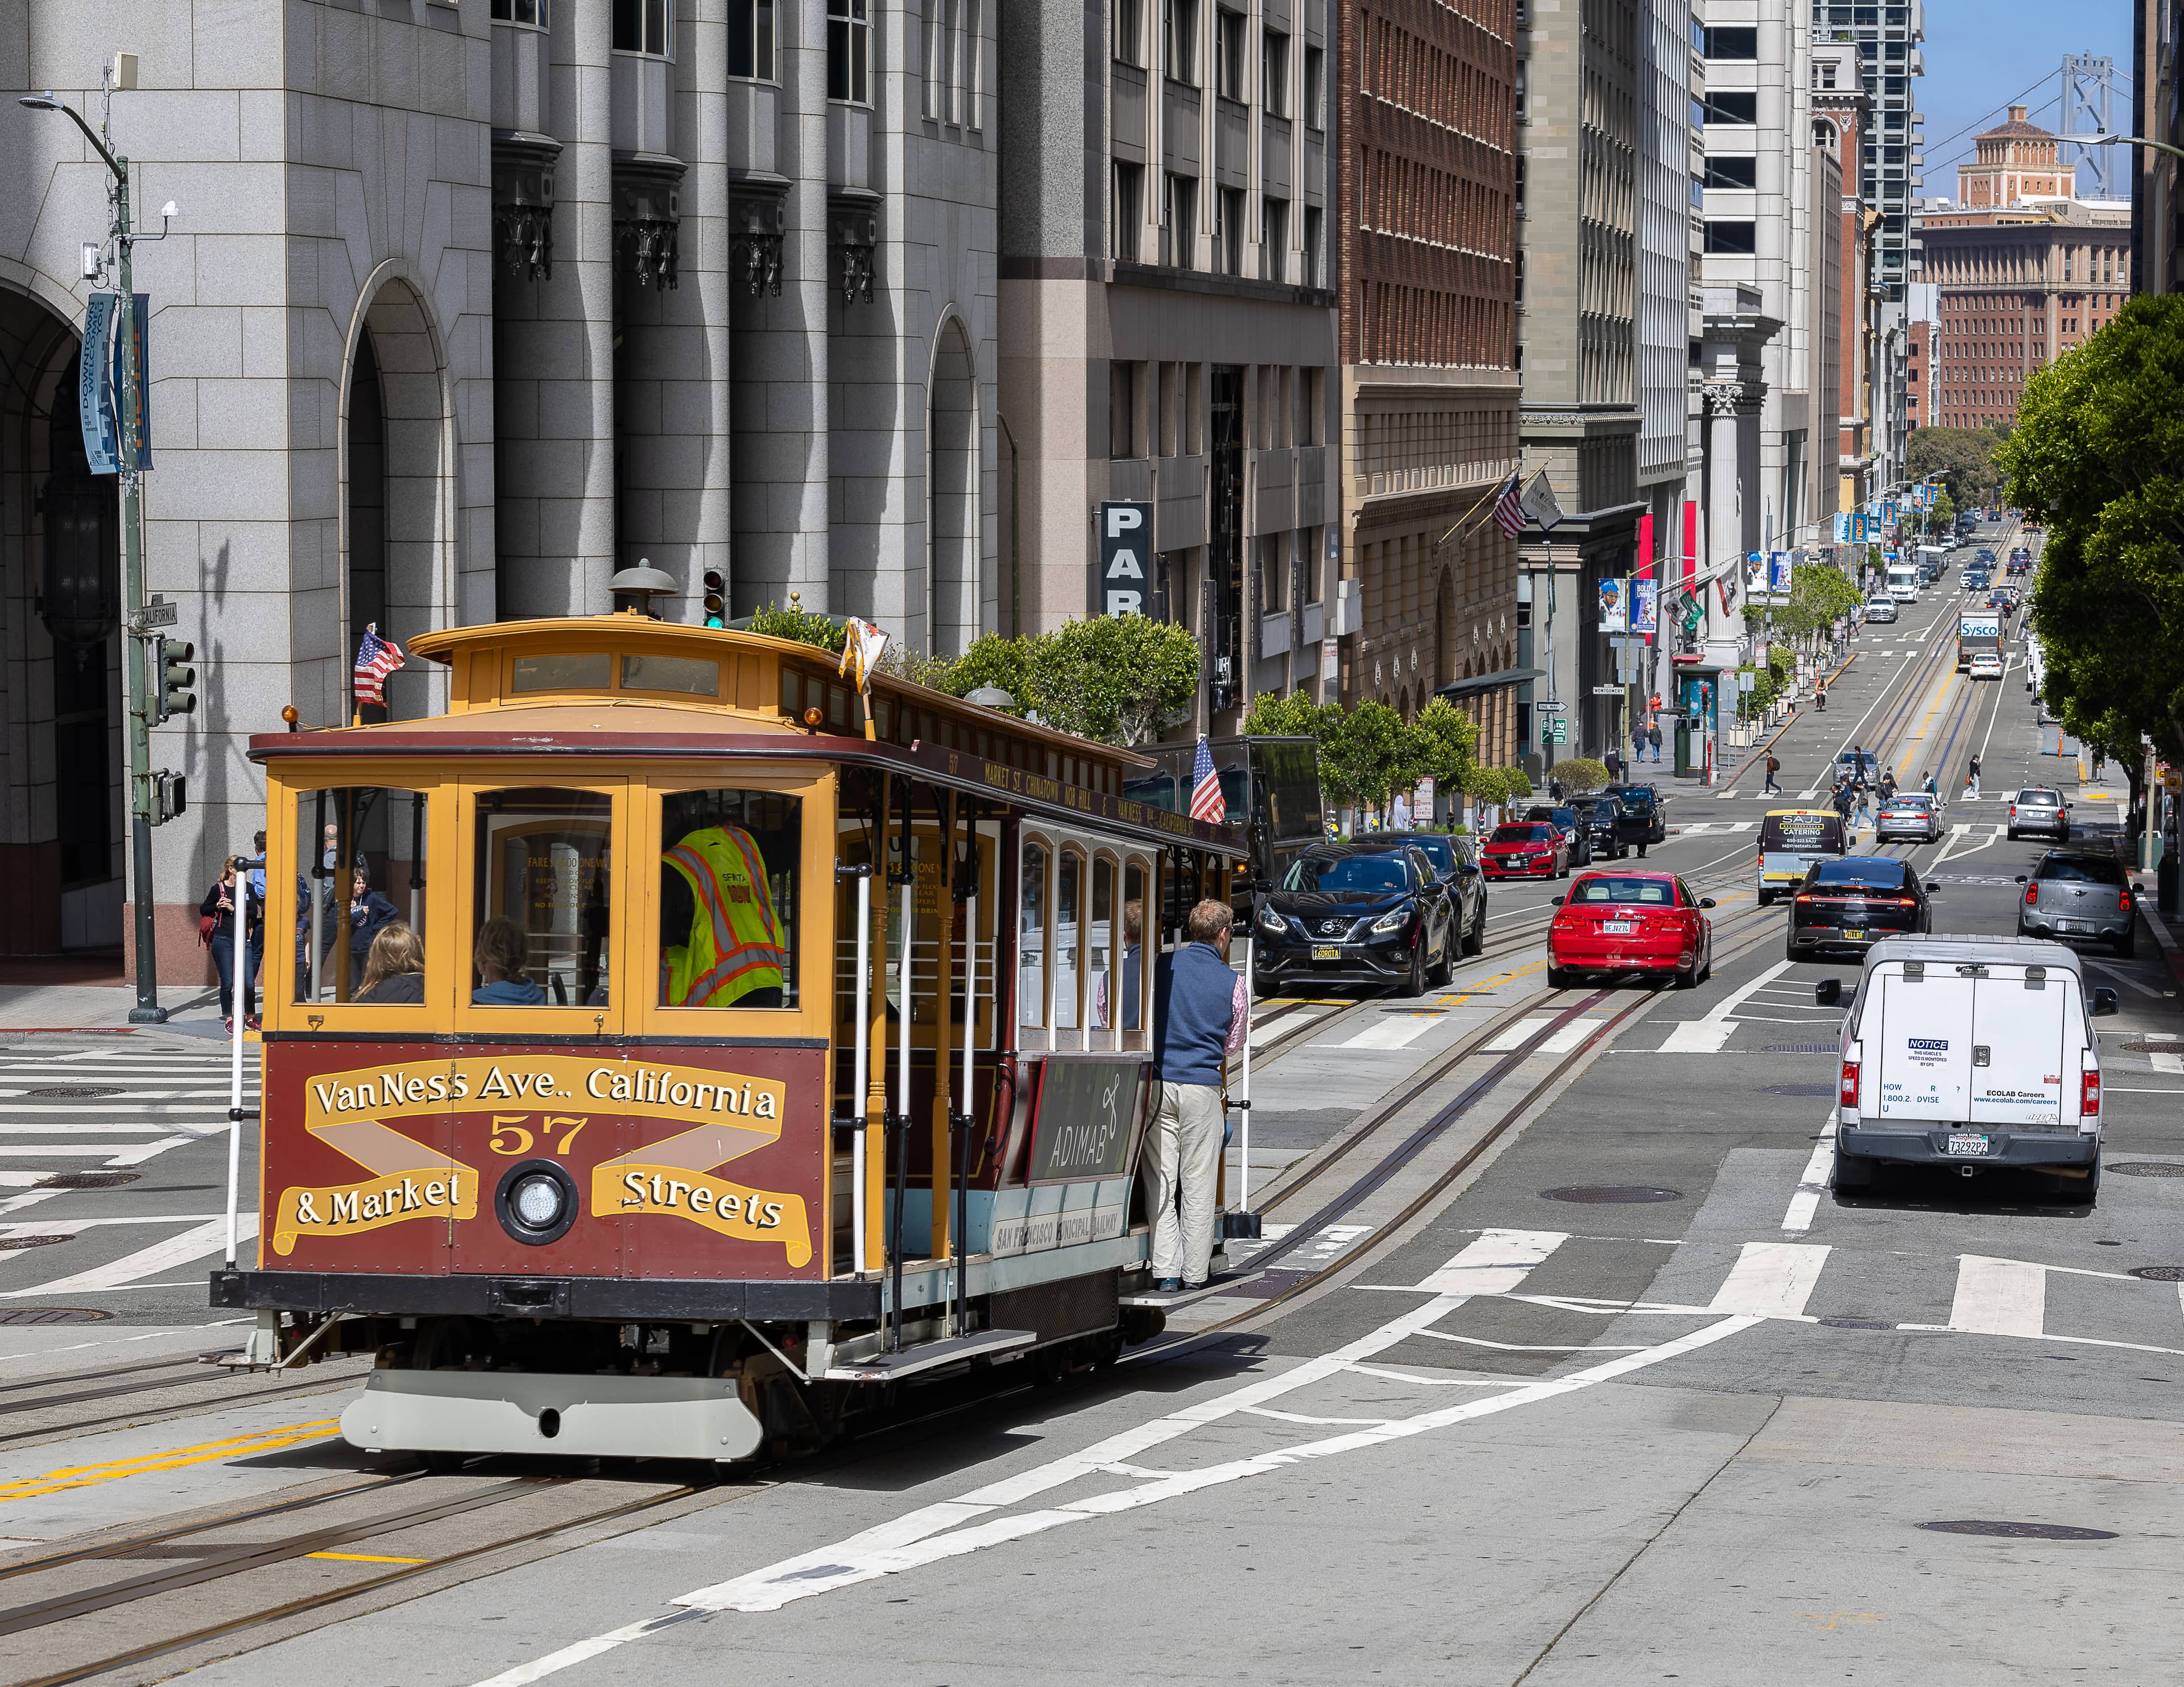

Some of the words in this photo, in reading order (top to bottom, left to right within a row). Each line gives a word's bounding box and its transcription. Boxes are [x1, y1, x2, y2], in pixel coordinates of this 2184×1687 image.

[83, 302, 96, 408] DOWNTOWN
[88, 301, 100, 393] WELCOMES
[1962, 623, 1997, 637] Sysco
[949, 754, 959, 774] 57
[985, 762, 1010, 789] MARKET
[1026, 775, 1059, 802] CHINATOWN
[1064, 786, 1076, 807] NOB
[1078, 790, 1091, 811] HILL
[1118, 801, 1129, 820] VAN
[1129, 803, 1143, 823] NESS
[1160, 811, 1187, 835] CALIFORNIA
[528, 857, 549, 867] FARE
[919, 863, 936, 873] ONE
[1910, 1040, 1947, 1049] NOTICE
[313, 1080, 377, 1115] Van
[379, 1071, 469, 1106] Ness
[586, 1067, 776, 1119] California
[489, 1115, 588, 1156] 57
[1050, 1125, 1107, 1167] ADIMAB
[1950, 1141, 1986, 1151] 73292P2
[296, 1192, 324, 1225] &
[326, 1174, 461, 1226] Market
[621, 1171, 785, 1230] Streets
[997, 1228, 1011, 1250] SAN
